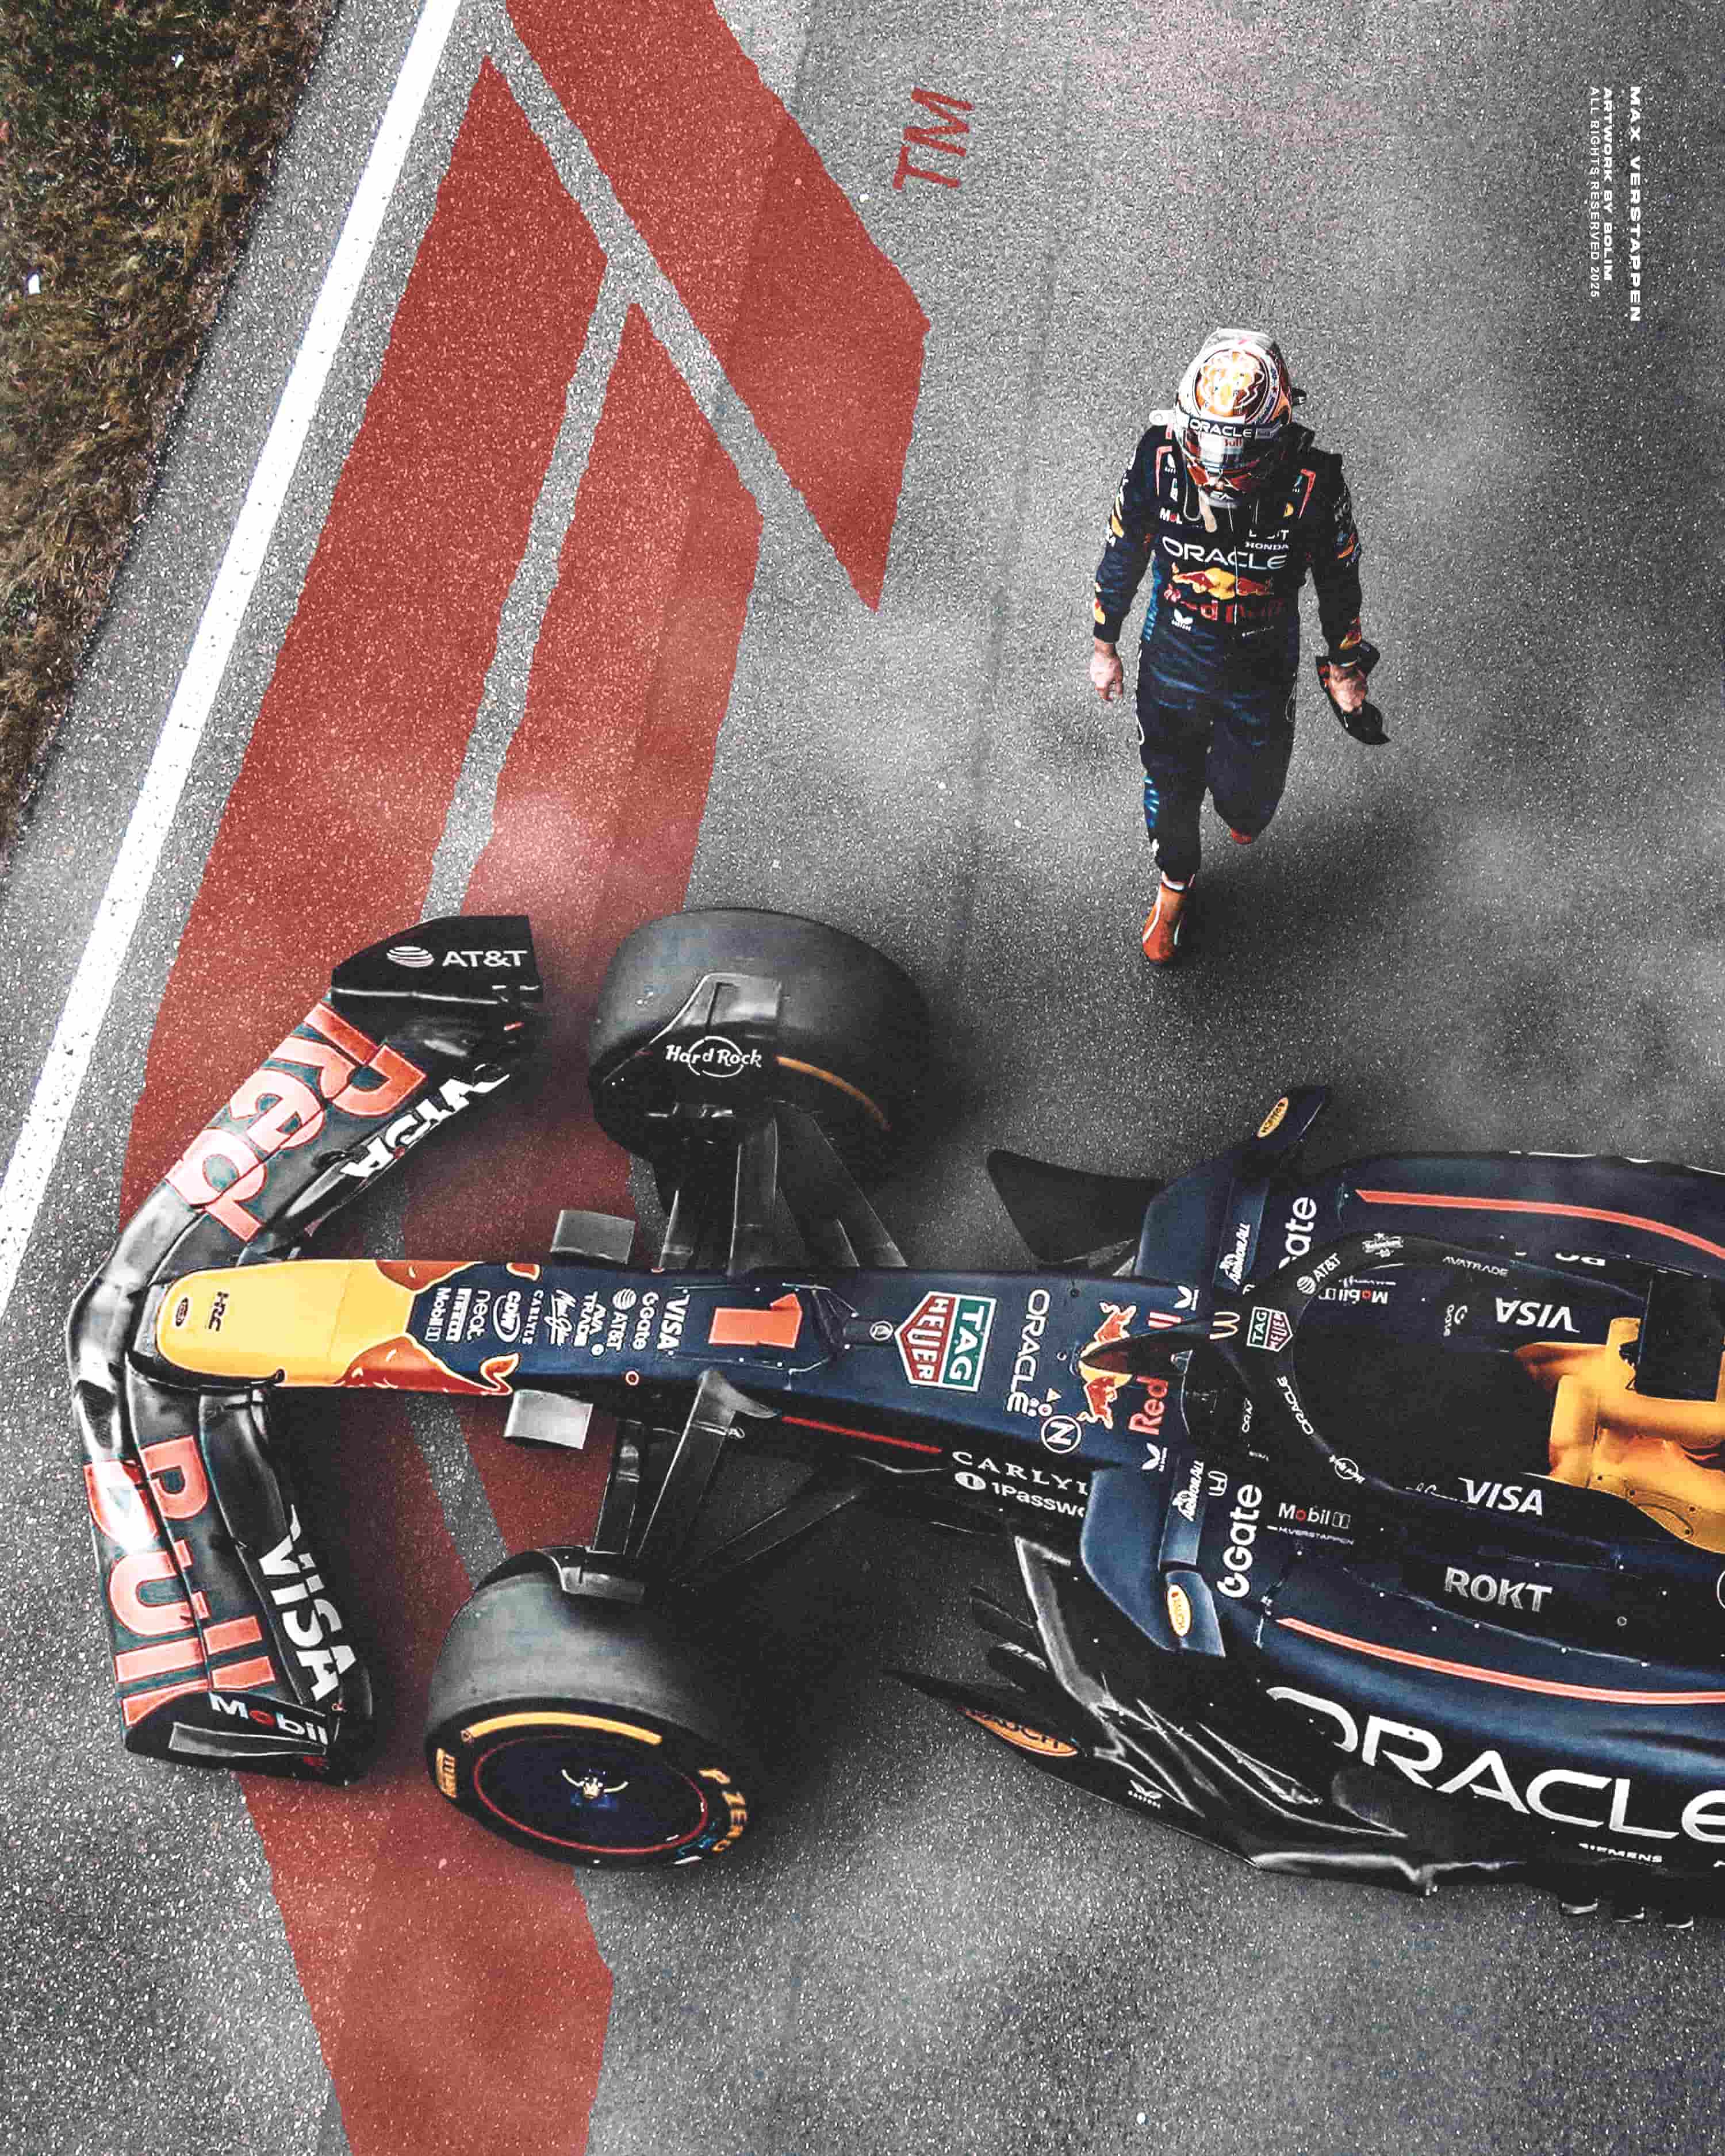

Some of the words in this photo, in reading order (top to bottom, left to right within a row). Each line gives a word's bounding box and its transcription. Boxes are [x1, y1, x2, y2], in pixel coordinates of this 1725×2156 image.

[892, 87, 974, 190] TM
[1190, 419, 1252, 438] ORACLE
[1162, 536, 1287, 570] ORACLE
[1245, 541, 1289, 551] HONDA
[442, 950, 528, 968] AT&T
[665, 1045, 713, 1065] Hard
[716, 1049, 762, 1068] Rock
[165, 1003, 426, 1242] Red
[340, 1074, 511, 1179] VISA
[1314, 1253, 1341, 1282] AT&T
[500, 1290, 522, 1332] CDW
[1339, 1288, 1389, 1306] Mobil
[1495, 1296, 1580, 1334] VISA
[589, 1303, 607, 1336] AVA
[606, 1311, 628, 1351] AT&T
[657, 1294, 690, 1351] VISA
[907, 1297, 950, 1380] HEUER
[1251, 1310, 1268, 1343] TAG
[949, 1305, 986, 1382] TAG
[1007, 1288, 1051, 1414] ORACLE
[1128, 1375, 1169, 1436] Red
[1276, 1375, 1314, 1435] ORACLE
[1278, 1502, 1331, 1525] Mobil
[1458, 1476, 1544, 1518] VISA
[82, 1435, 276, 1727] Bull
[1444, 1566, 1552, 1613] ROKT
[258, 1503, 357, 1702] VISA
[209, 1693, 329, 1745] Mobil
